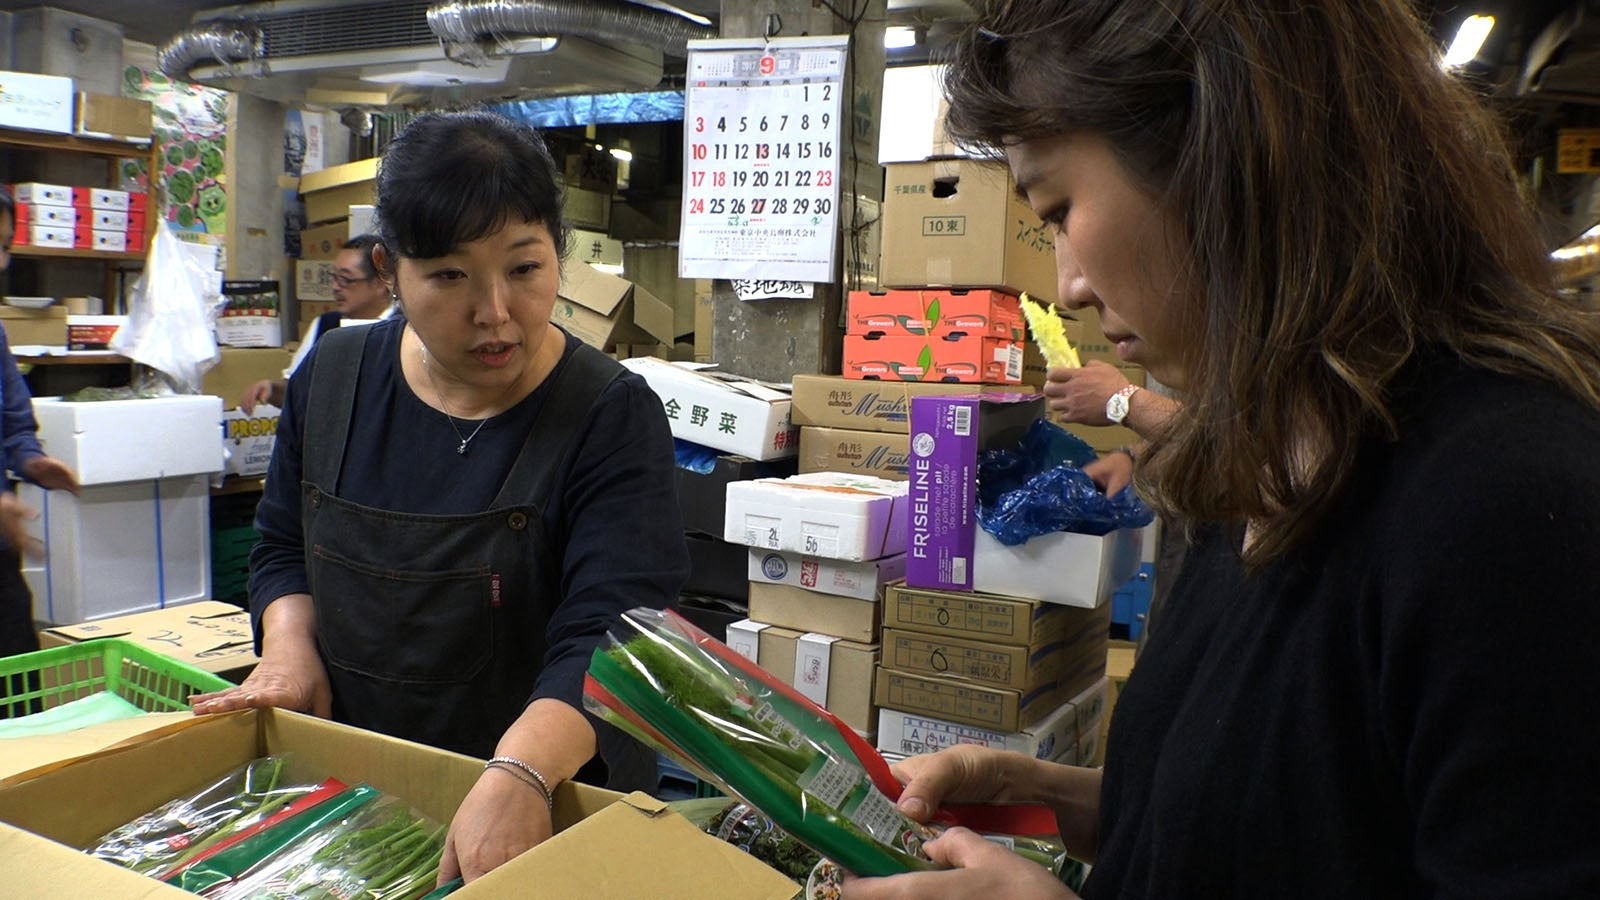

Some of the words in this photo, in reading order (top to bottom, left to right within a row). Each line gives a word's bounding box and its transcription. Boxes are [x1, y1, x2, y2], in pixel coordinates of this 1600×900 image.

[760, 57, 775, 74] 9
[804, 86, 809, 102] 1
[823, 85, 831, 101] 2
[696, 117, 704, 132] 3
[717, 117, 726, 132] 4
[740, 117, 748, 132] 5
[760, 116, 768, 132] 6
[780, 115, 788, 131] 7
[801, 114, 810, 130] 8
[822, 113, 830, 129] 9
[692, 144, 707, 160] 10
[715, 144, 727, 160] 11
[735, 144, 749, 159] 12
[756, 144, 769, 159] 13
[777, 143, 790, 159] 14
[798, 142, 811, 158] 15
[818, 142, 832, 158] 16
[692, 172, 705, 186] 17
[713, 172, 726, 186] 18
[733, 171, 747, 186] 19
[753, 171, 768, 186] 20
[775, 171, 788, 186] 21
[795, 171, 811, 186] 22
[816, 170, 832, 186] 23
[690, 199, 704, 214] 24
[710, 199, 725, 214] 25
[730, 199, 746, 214] 26
[751, 199, 767, 214] 27
[772, 199, 787, 214] 28
[792, 199, 809, 214] 29
[814, 199, 831, 214] 30
[929, 220, 943, 232] 10
[934, 471, 943, 484] pit
[942, 464, 950, 494] salade
[914, 460, 929, 558] FRISELINE
[911, 729, 920, 740] A
